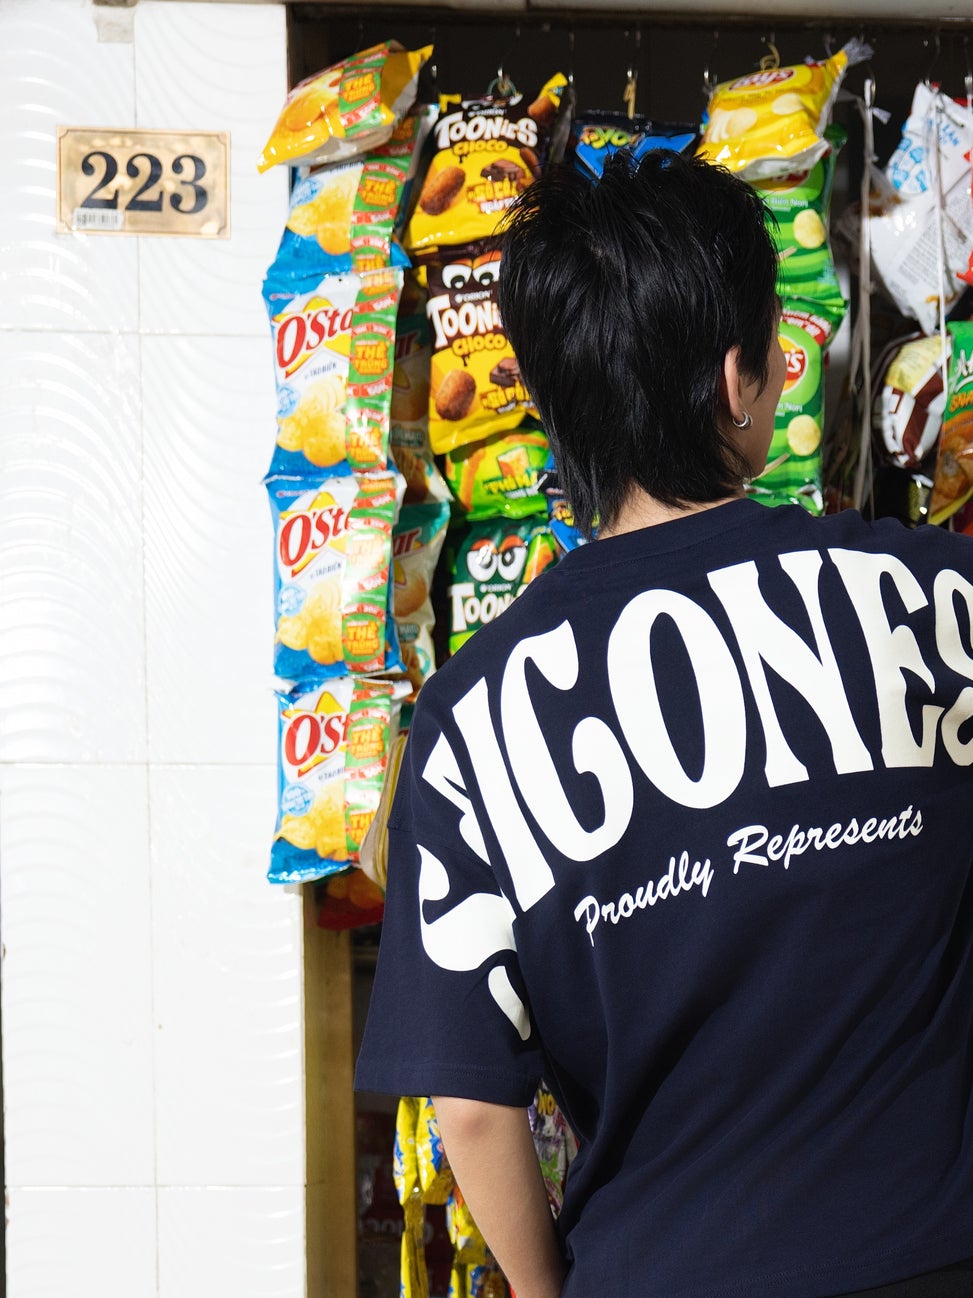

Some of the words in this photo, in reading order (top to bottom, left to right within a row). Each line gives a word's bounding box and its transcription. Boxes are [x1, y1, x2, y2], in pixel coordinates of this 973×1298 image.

[80, 150, 208, 214] 223
[276, 308, 353, 369] O'Sta
[279, 507, 350, 568] O'St
[573, 850, 715, 947] Proudly
[726, 804, 924, 875] Represents
